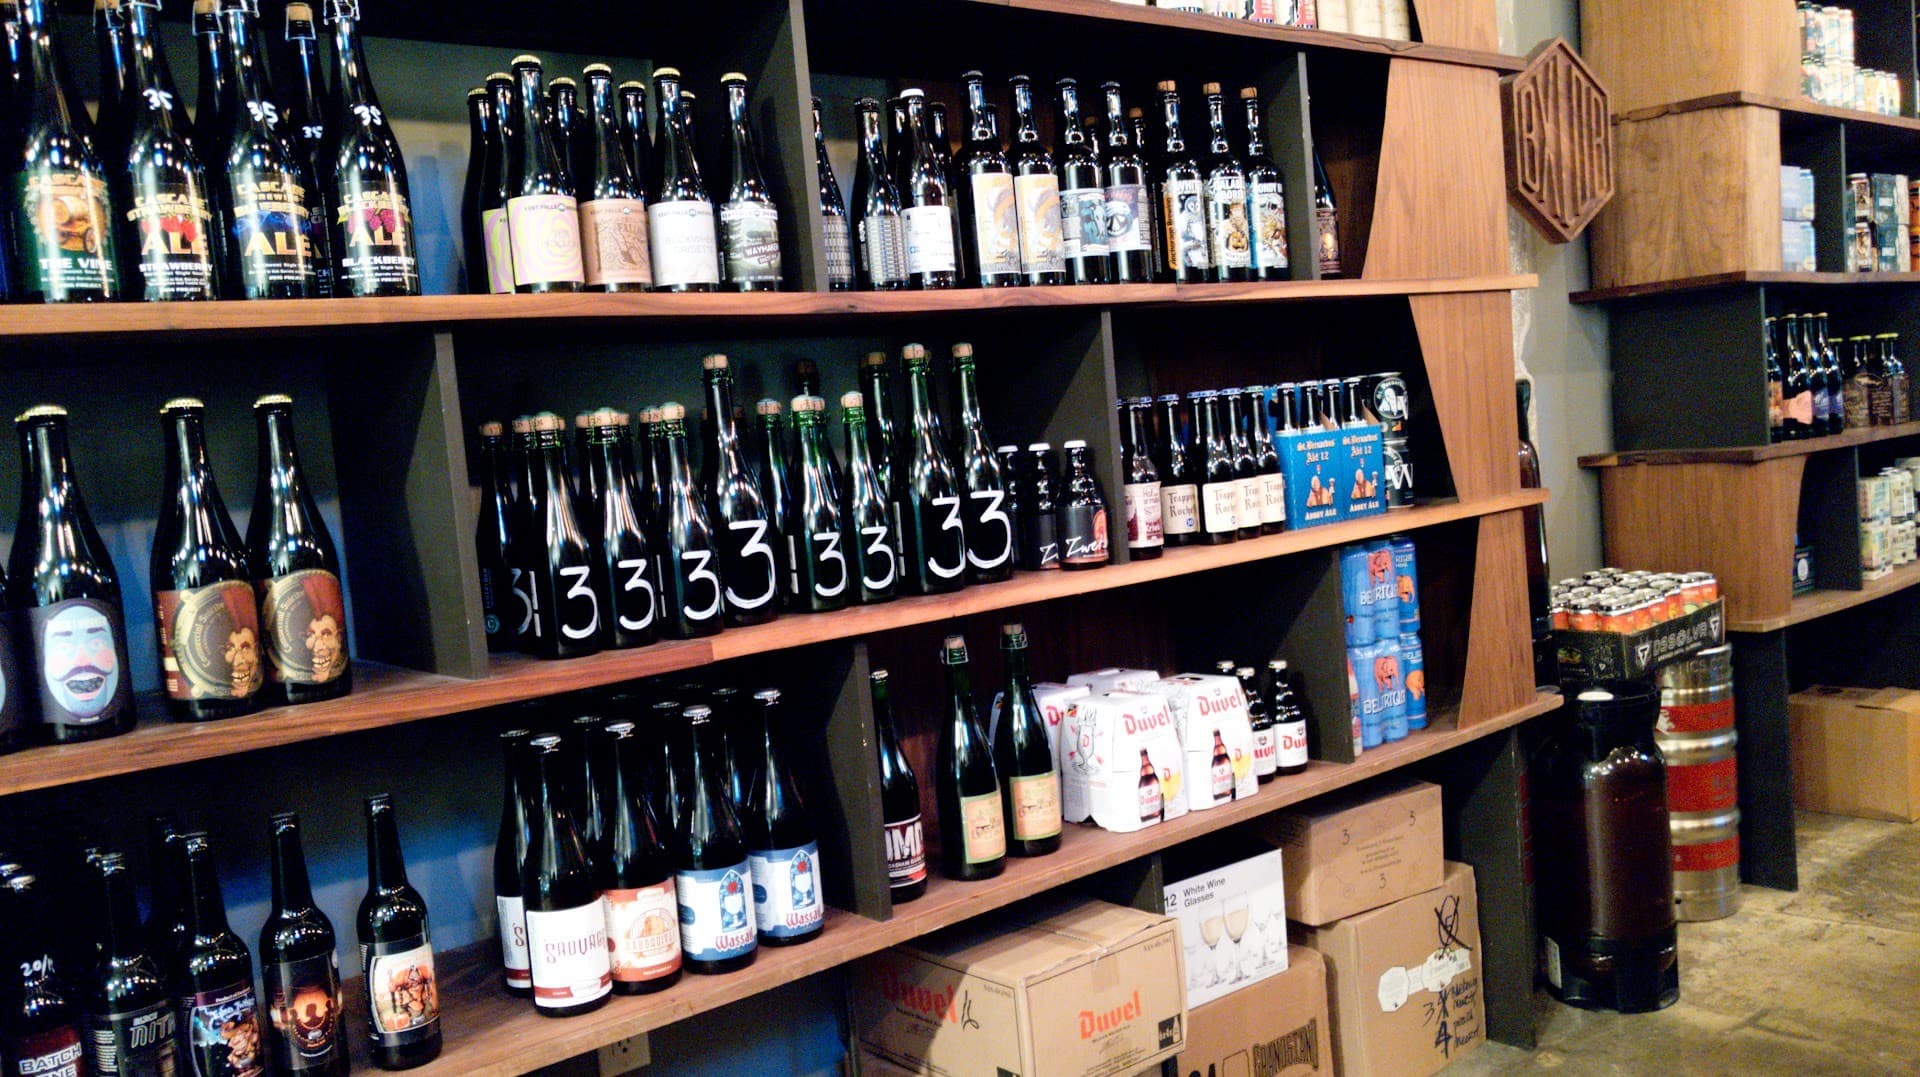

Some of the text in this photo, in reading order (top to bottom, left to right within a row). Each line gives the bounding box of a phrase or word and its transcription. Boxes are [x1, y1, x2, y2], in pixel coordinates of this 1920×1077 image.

[142, 88, 173, 111] 35
[247, 101, 278, 128] 35
[353, 105, 382, 126] 35
[302, 125, 322, 139] 35
[141, 230, 209, 256] ALE
[244, 231, 312, 258] ALE
[350, 225, 407, 247] ALE
[928, 496, 966, 578] 3
[967, 490, 1012, 569] 3
[725, 519, 776, 609] 3
[813, 532, 847, 597] 3
[861, 526, 895, 590] 3
[617, 559, 655, 631] 3
[681, 550, 719, 620] 3
[560, 565, 599, 640] 3
[1197, 687, 1243, 717] Duvel
[1123, 704, 1172, 736] Duvel
[1163, 893, 1178, 909] 12
[1182, 877, 1226, 898] White Wine
[1184, 891, 1214, 908] Glasses
[1079, 990, 1142, 1040] Duvel
[19, 1041, 83, 1075] BATCH
